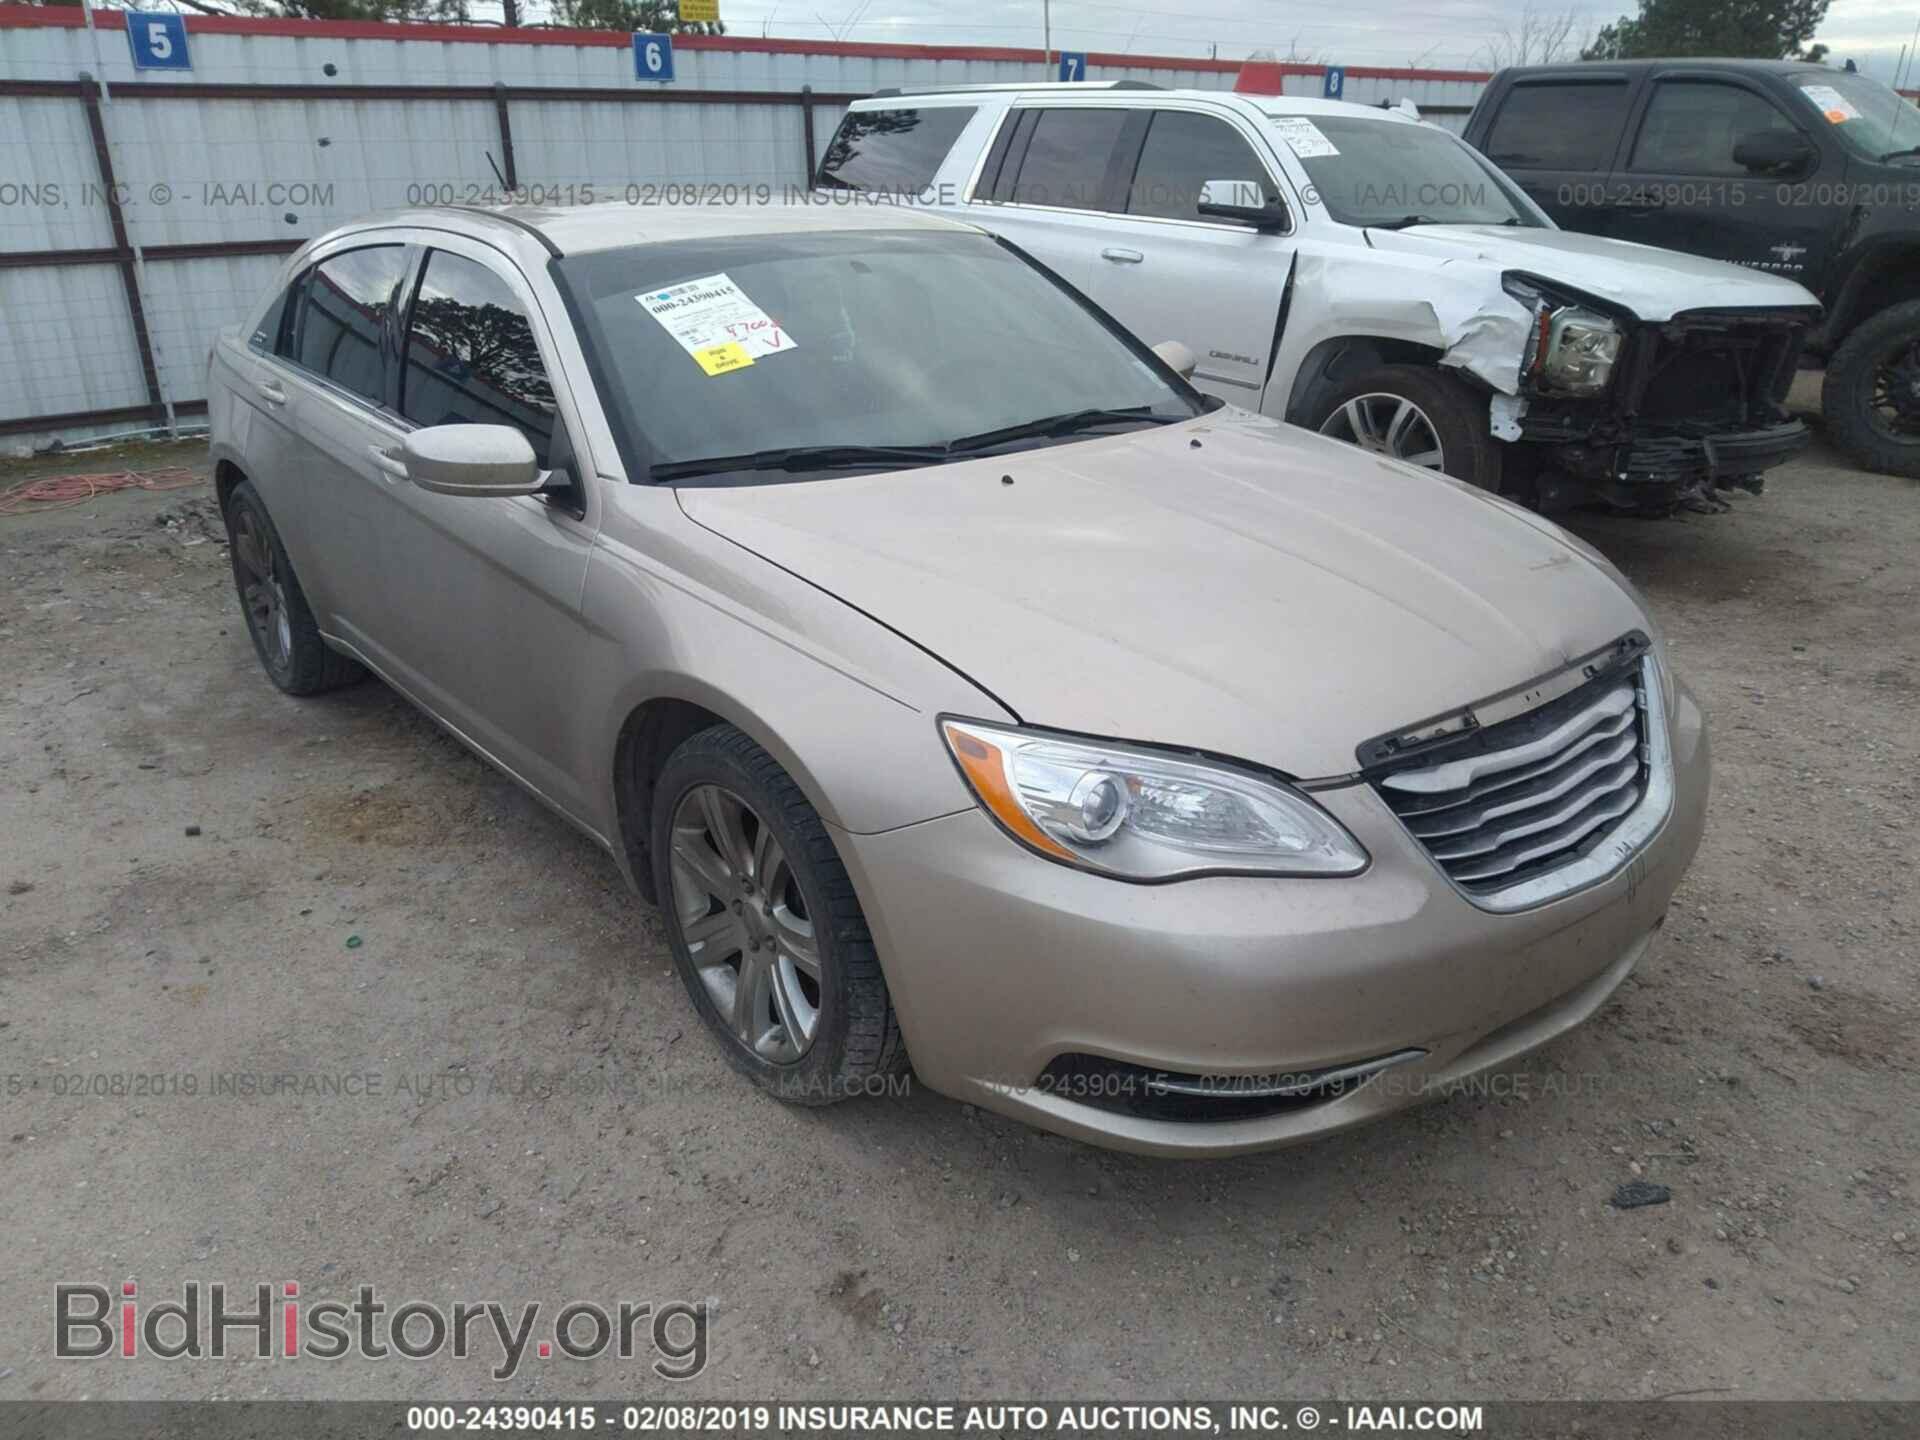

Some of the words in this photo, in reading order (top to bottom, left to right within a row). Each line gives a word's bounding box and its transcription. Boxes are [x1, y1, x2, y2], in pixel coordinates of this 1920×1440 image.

[148, 23, 172, 58] 5
[645, 41, 662, 72] 6
[1067, 59, 1078, 82] 7
[1330, 71, 1339, 92] 8
